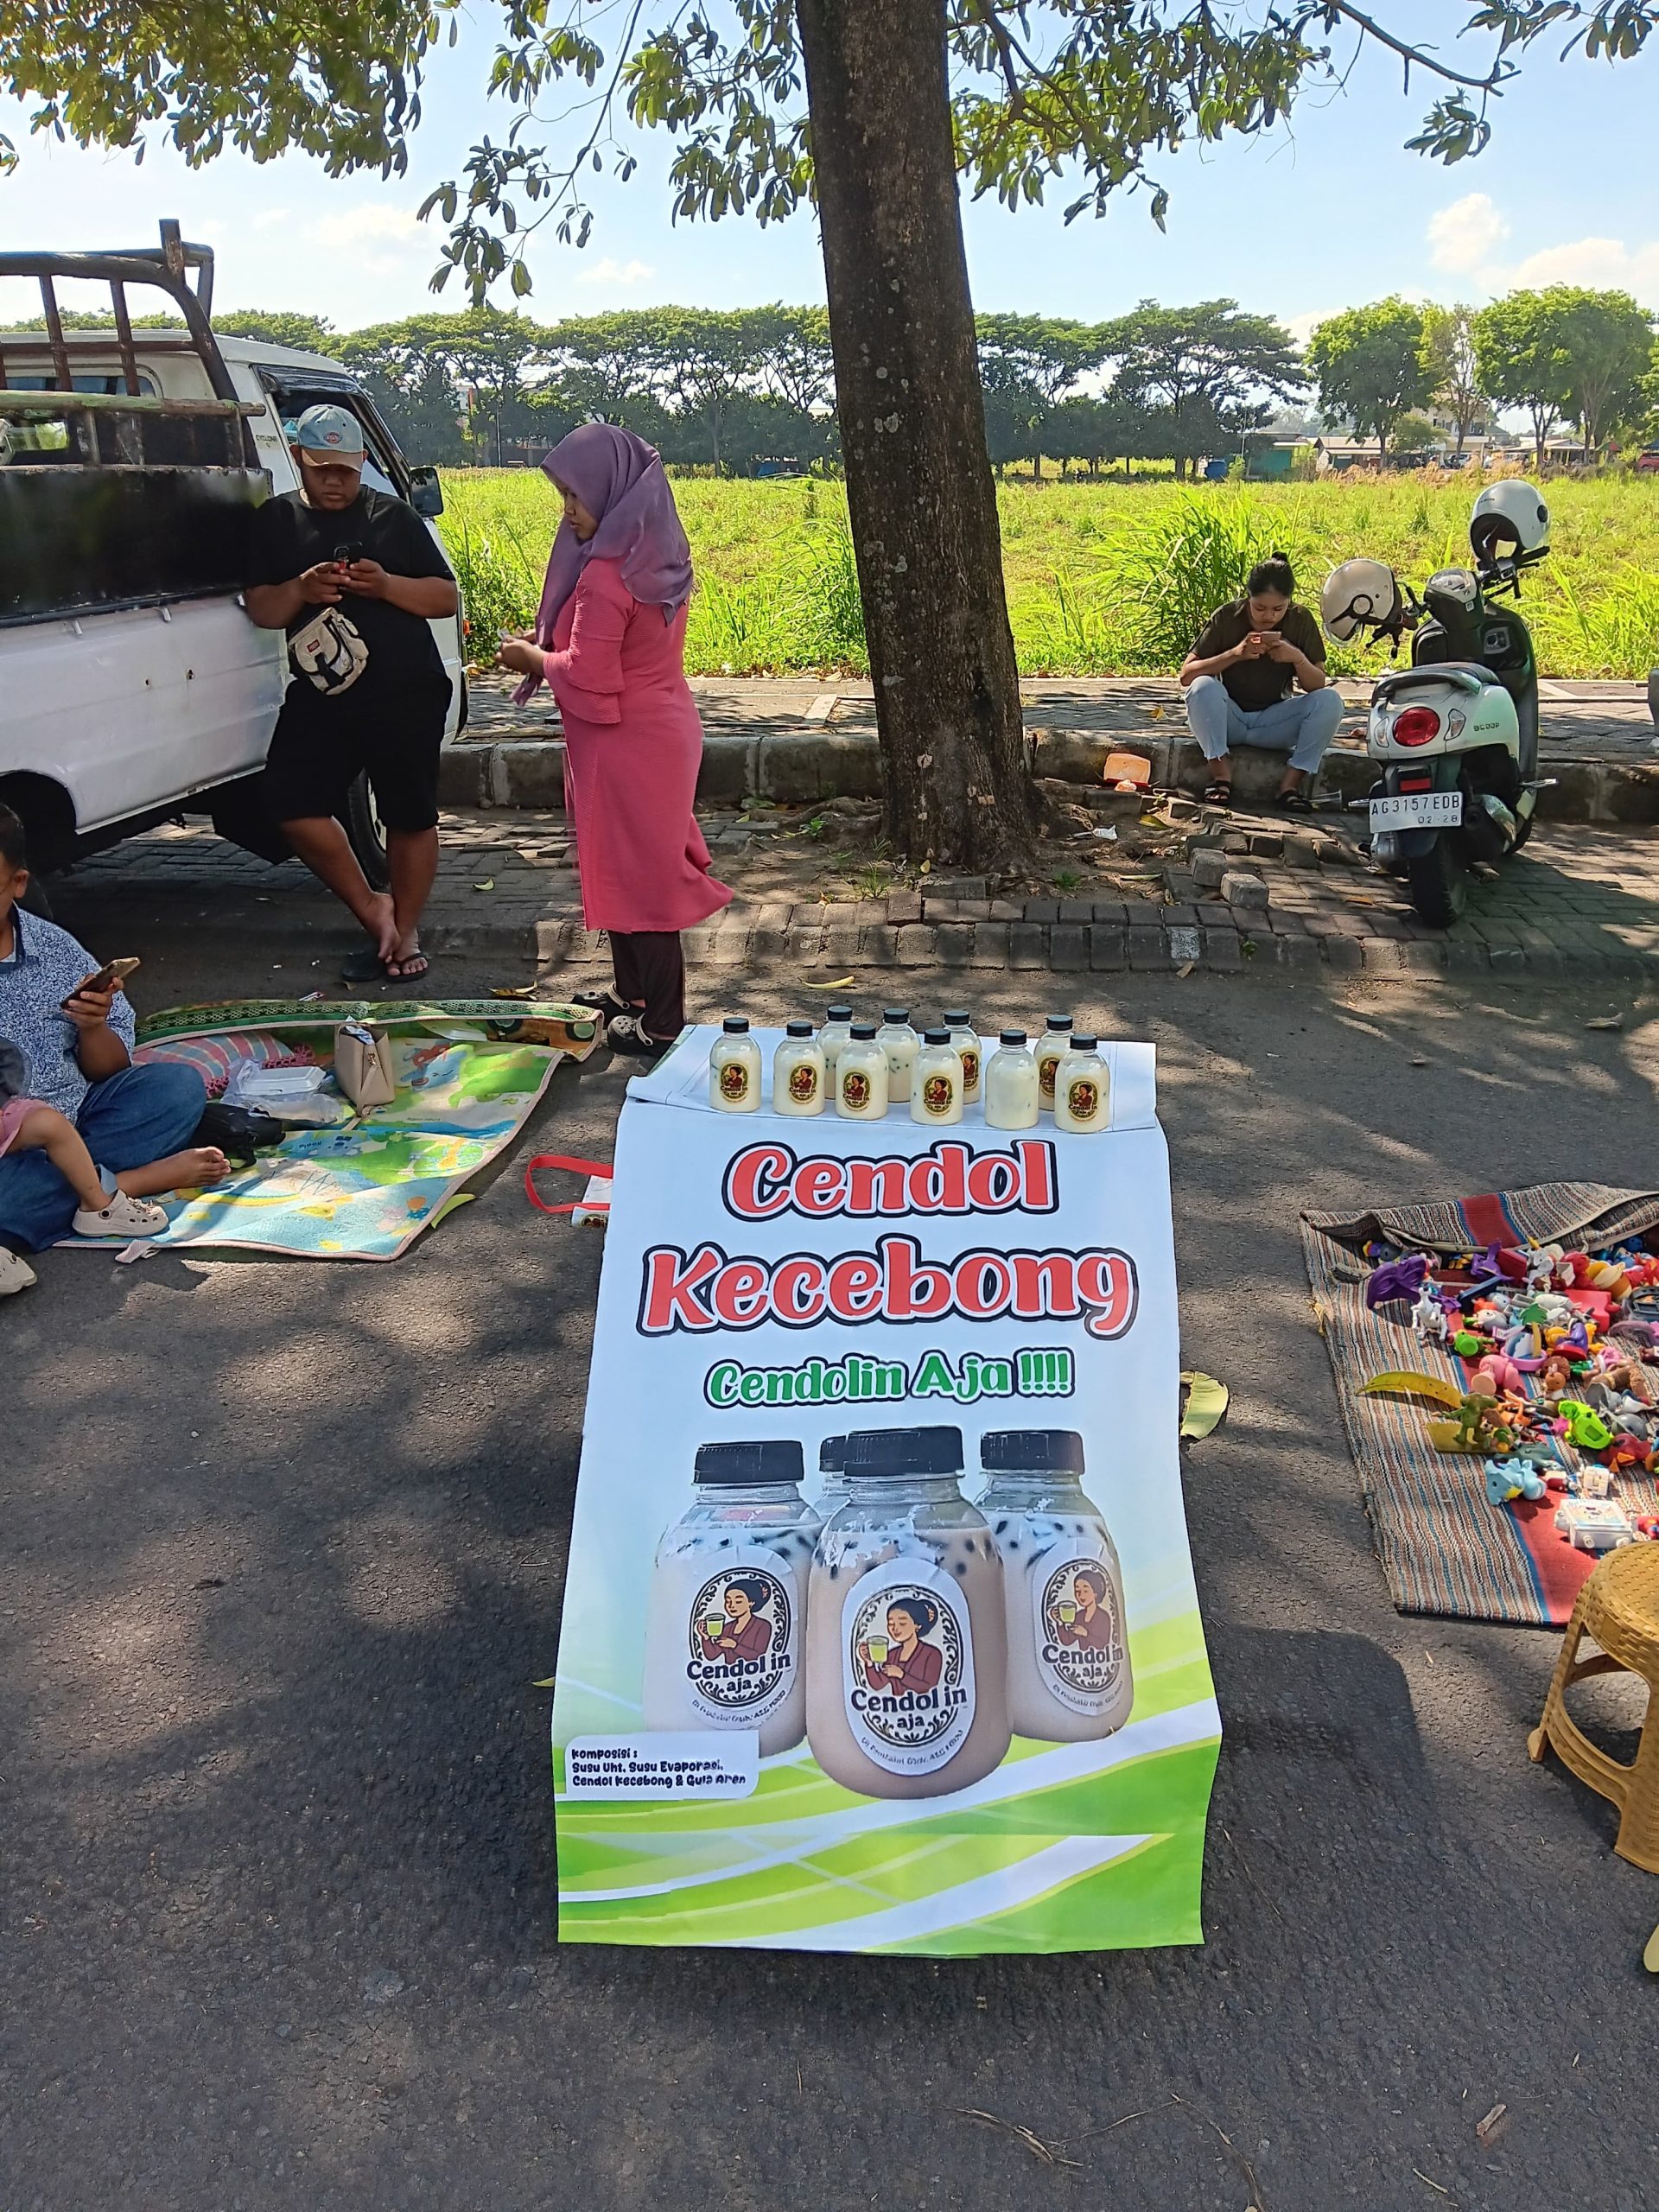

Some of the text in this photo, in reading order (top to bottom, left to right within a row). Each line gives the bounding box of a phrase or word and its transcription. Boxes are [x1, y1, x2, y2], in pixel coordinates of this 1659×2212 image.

[1371, 795, 1459, 815] AG 3157 EDB
[726, 1141, 1056, 1219] Cendol
[640, 1236, 1135, 1336] Kecebong
[708, 1350, 1071, 1405] Cendolin Aja !!!!
[1042, 1644, 1110, 1664] Cendol
[687, 1653, 791, 1680] Cendol in
[1083, 1664, 1103, 1679] aja
[727, 1678, 752, 1694] aja
[851, 1686, 967, 1713] Cendol in
[897, 1713, 925, 1731] aja
[572, 1762, 600, 1773] Susu
[629, 1762, 658, 1772] Susu
[573, 1776, 613, 1787] Cendol
[676, 1775, 683, 1786] &
[687, 1775, 713, 1786] Gula
[715, 1774, 746, 1784] Aren
